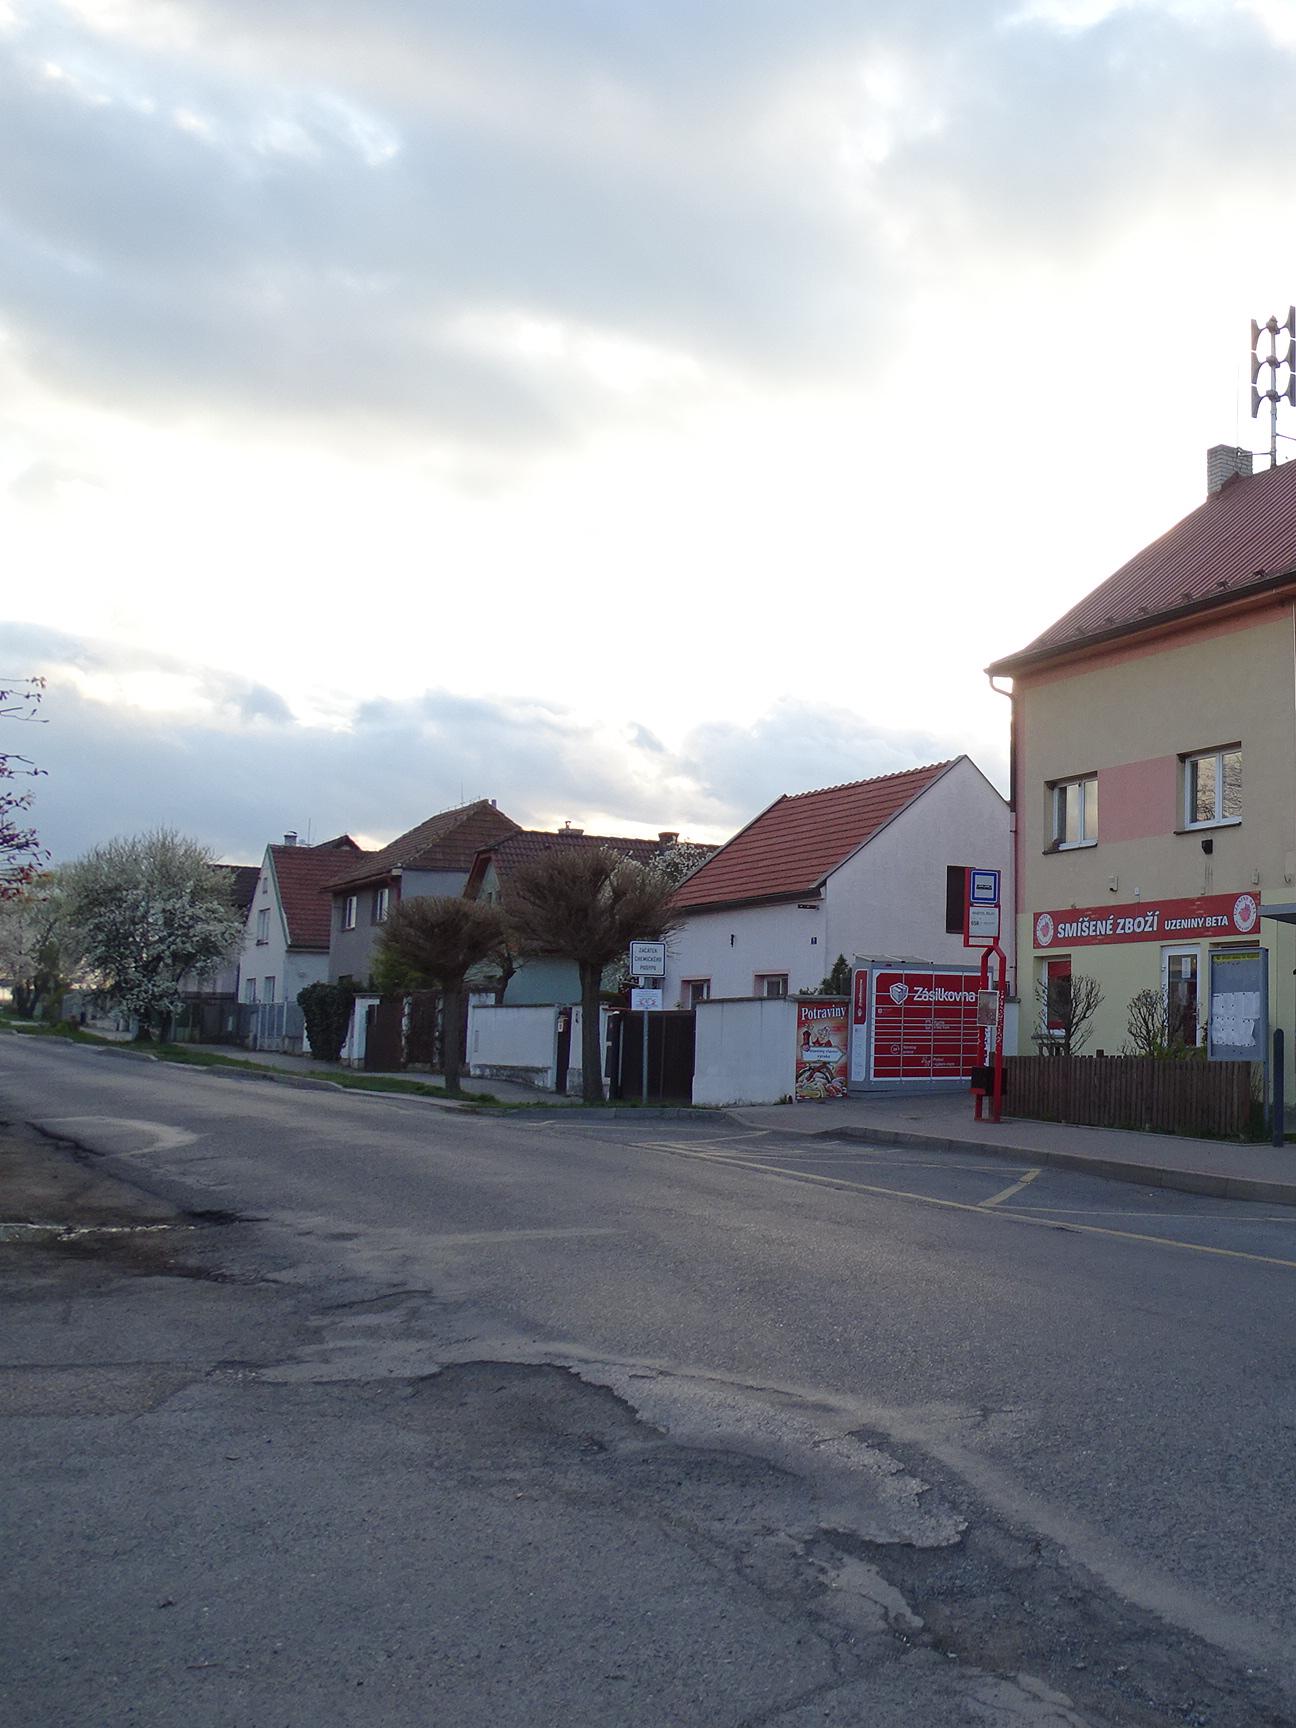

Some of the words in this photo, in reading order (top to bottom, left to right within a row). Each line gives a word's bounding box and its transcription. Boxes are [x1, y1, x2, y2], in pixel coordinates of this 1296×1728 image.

[1057, 915, 1114, 938] SMÍŠENÉ
[1116, 911, 1160, 932] ZBOŽÍ
[1164, 918, 1205, 931] UZENINY
[1205, 915, 1229, 928] BETA
[913, 986, 976, 1002] Zásilkovna
[800, 1004, 847, 1021] Potraviny
